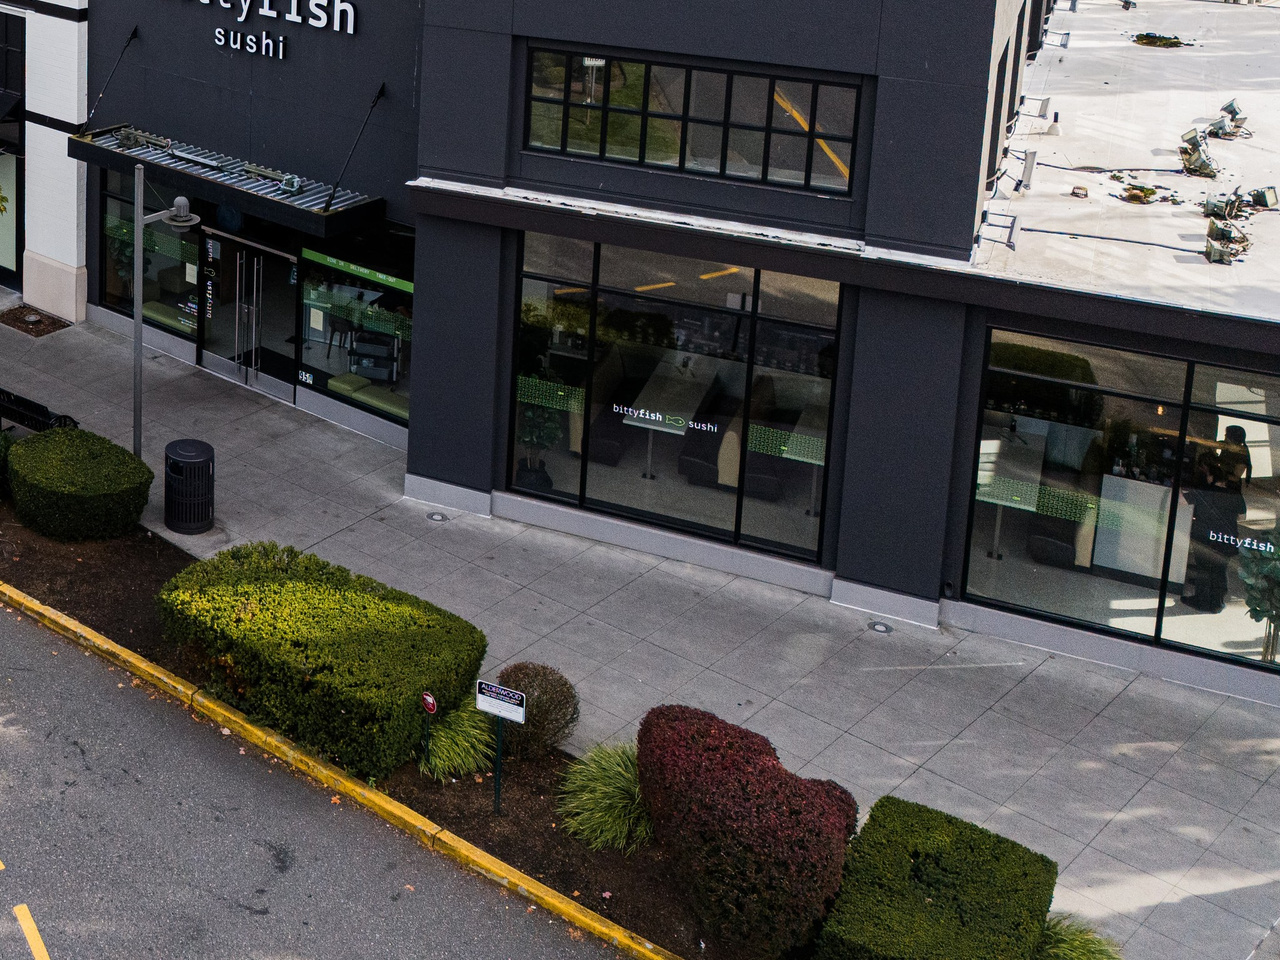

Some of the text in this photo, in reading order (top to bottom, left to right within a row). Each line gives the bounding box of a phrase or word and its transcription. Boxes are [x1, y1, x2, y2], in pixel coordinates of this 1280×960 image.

[214, 27, 285, 60] sushi
[206, 281, 215, 319] bittyfish
[613, 403, 718, 433] bittyfish sushi
[1209, 530, 1274, 553] bittyfish
[481, 683, 522, 700] ALDERWOOD
